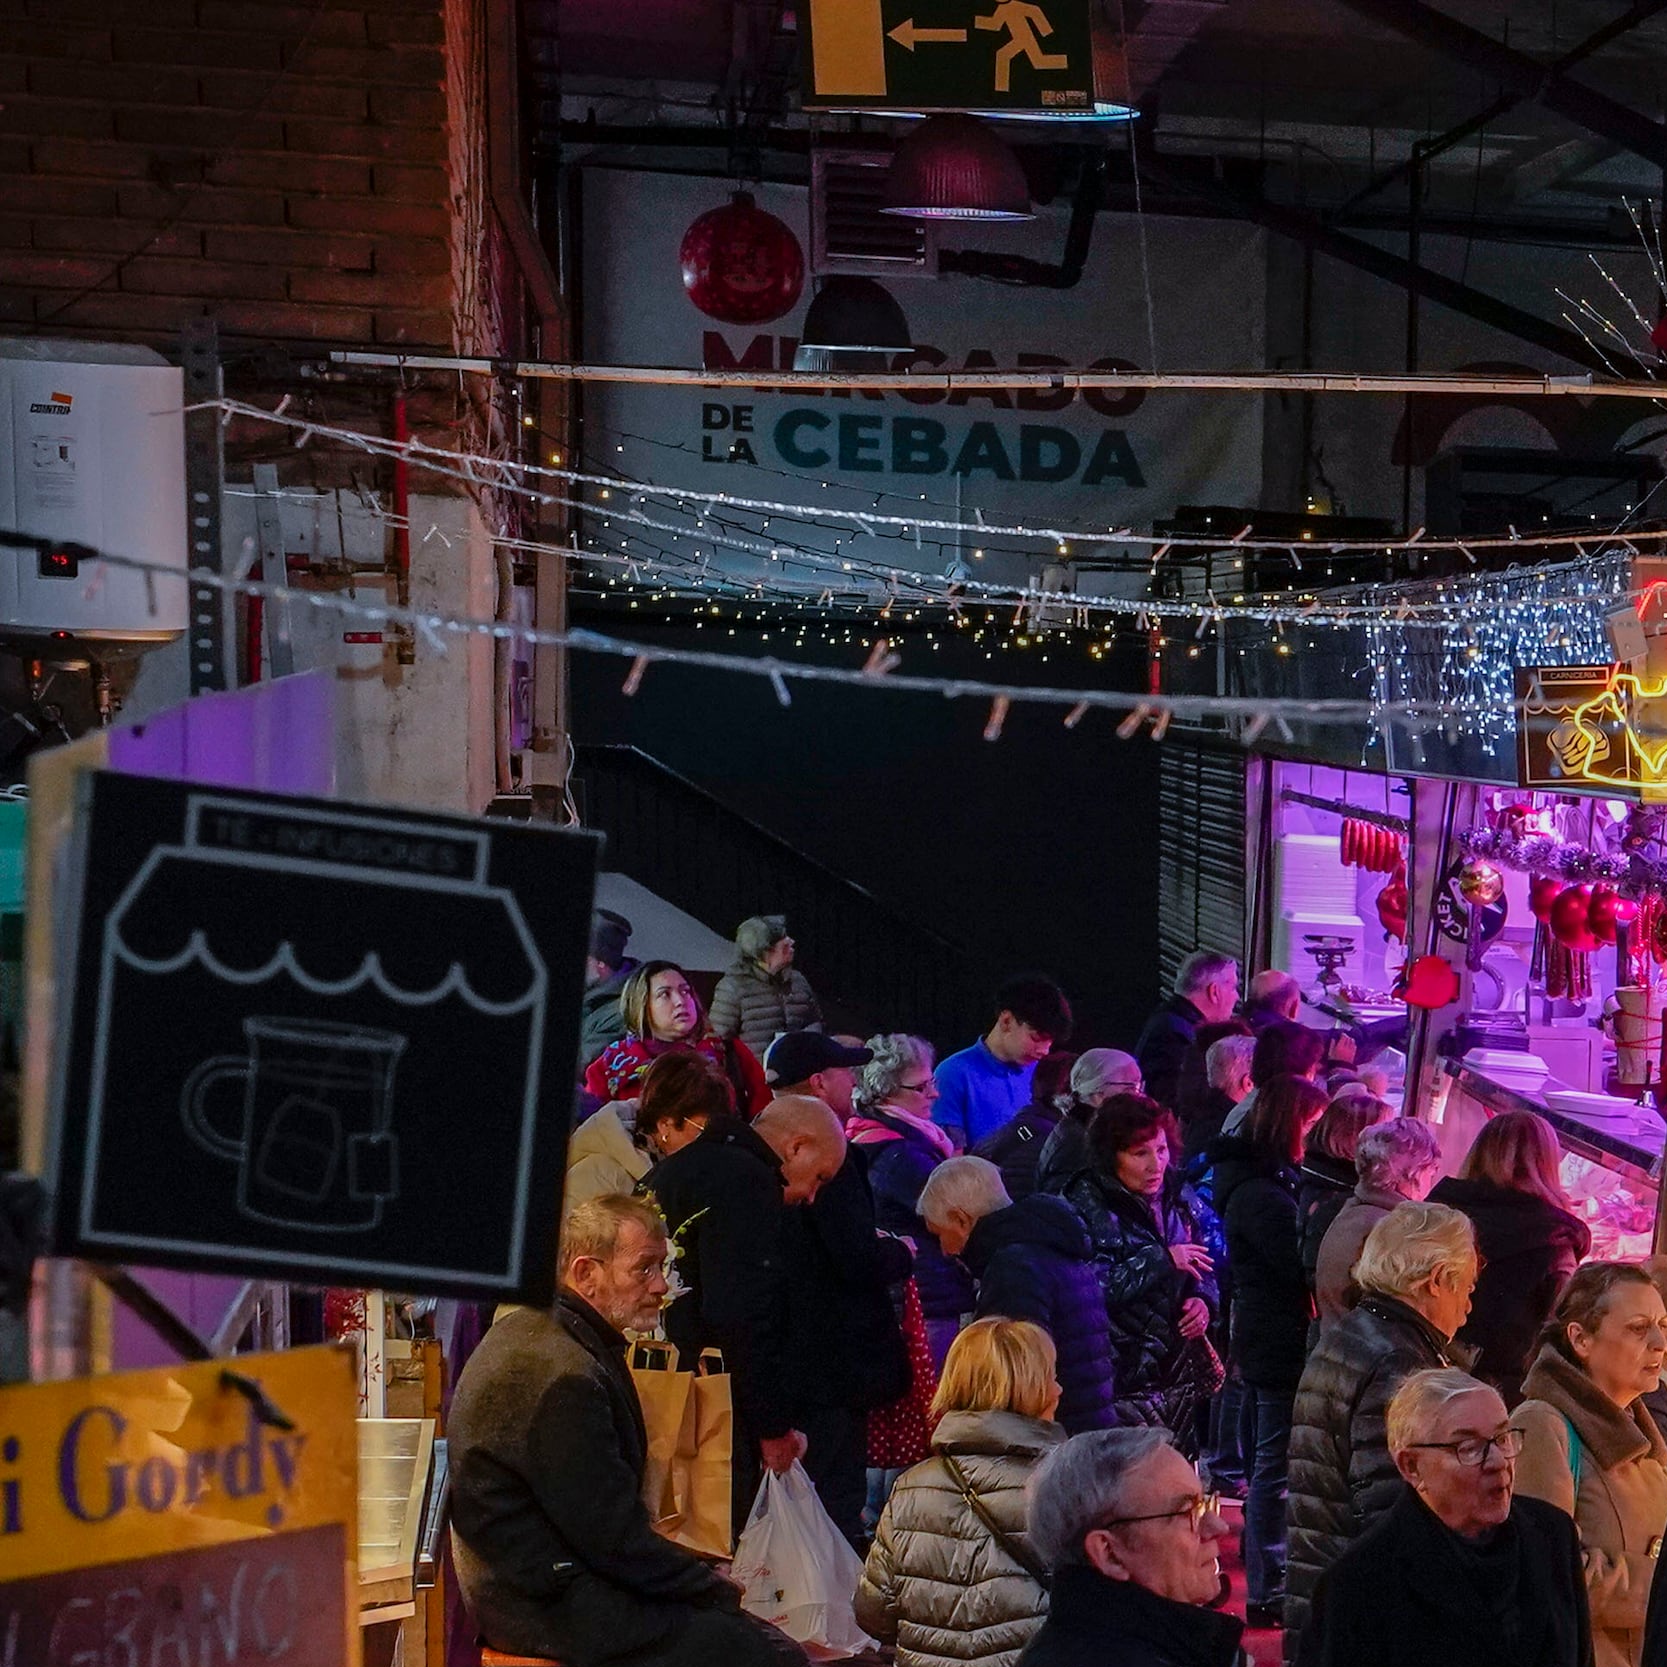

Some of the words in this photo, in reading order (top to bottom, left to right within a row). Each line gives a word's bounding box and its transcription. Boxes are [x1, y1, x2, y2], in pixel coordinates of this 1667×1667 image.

[702, 403, 754, 432] DE
[702, 435, 759, 465] LA
[773, 407, 1148, 488] CEBADA
[57, 1380, 307, 1529] Gordy
